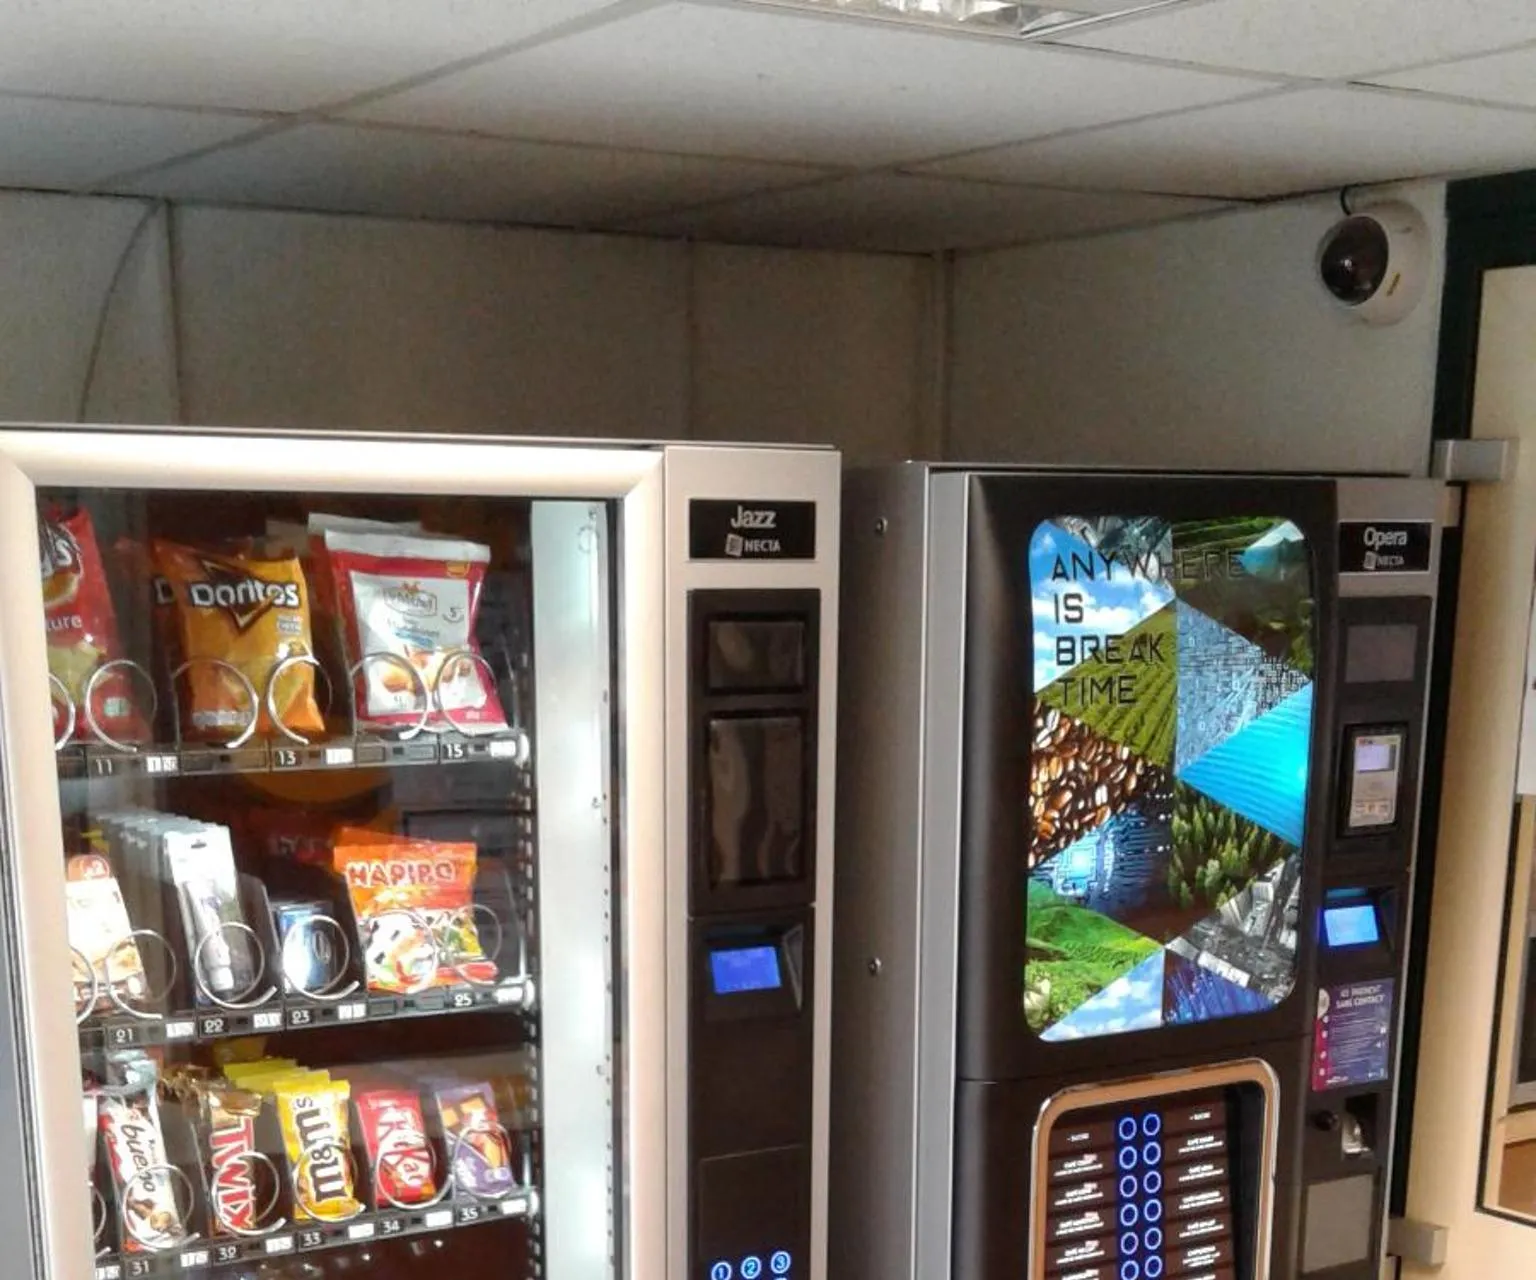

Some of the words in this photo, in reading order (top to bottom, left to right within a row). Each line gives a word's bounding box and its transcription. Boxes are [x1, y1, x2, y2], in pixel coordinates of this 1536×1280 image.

[730, 504, 777, 529] Jazz
[745, 539, 781, 553] NECTA
[1363, 526, 1408, 551] Opera
[1051, 551, 1247, 582] ANYWHERE
[190, 577, 299, 608] Doritos
[1053, 593, 1085, 624] IS
[1055, 633, 1166, 667] BREAK
[1056, 675, 1138, 706] TIME
[278, 750, 297, 766] 13
[446, 743, 464, 759] 15
[96, 758, 113, 776] 11
[348, 860, 456, 889] HARIBO
[454, 994, 473, 1007] 25
[121, 1123, 157, 1193] bueno
[210, 1114, 256, 1229] TWIX
[383, 1219, 401, 1233] 34
[461, 1206, 479, 1221] 35
[303, 1231, 322, 1247] 33
[131, 1260, 150, 1277] 31
